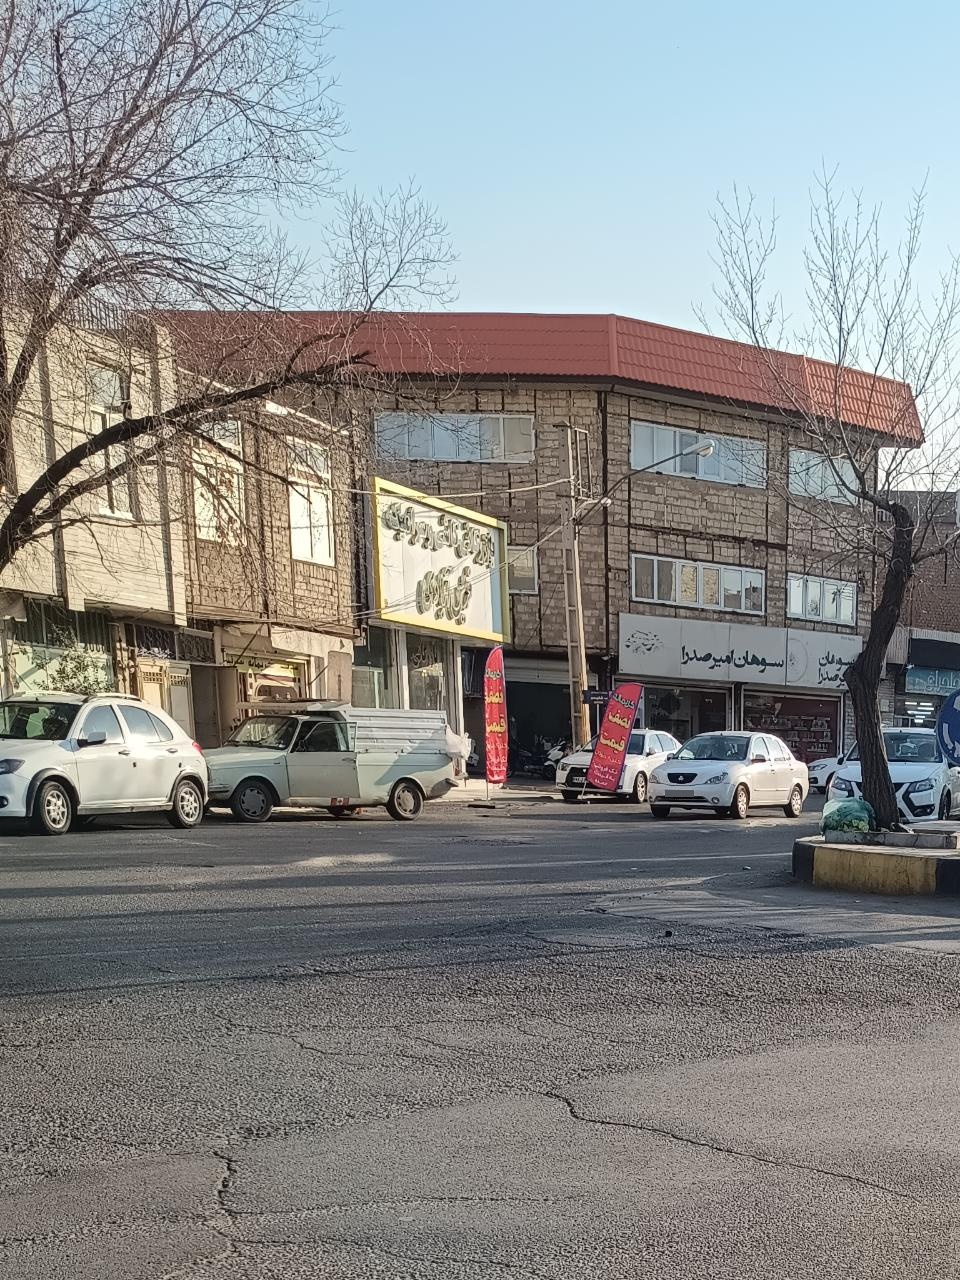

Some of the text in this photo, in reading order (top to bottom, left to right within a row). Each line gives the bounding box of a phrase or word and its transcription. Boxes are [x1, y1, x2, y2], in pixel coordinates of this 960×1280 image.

[733, 649, 784, 673] سوهان
[608, 709, 632, 729] نصف
[600, 731, 626, 754] قیمت
